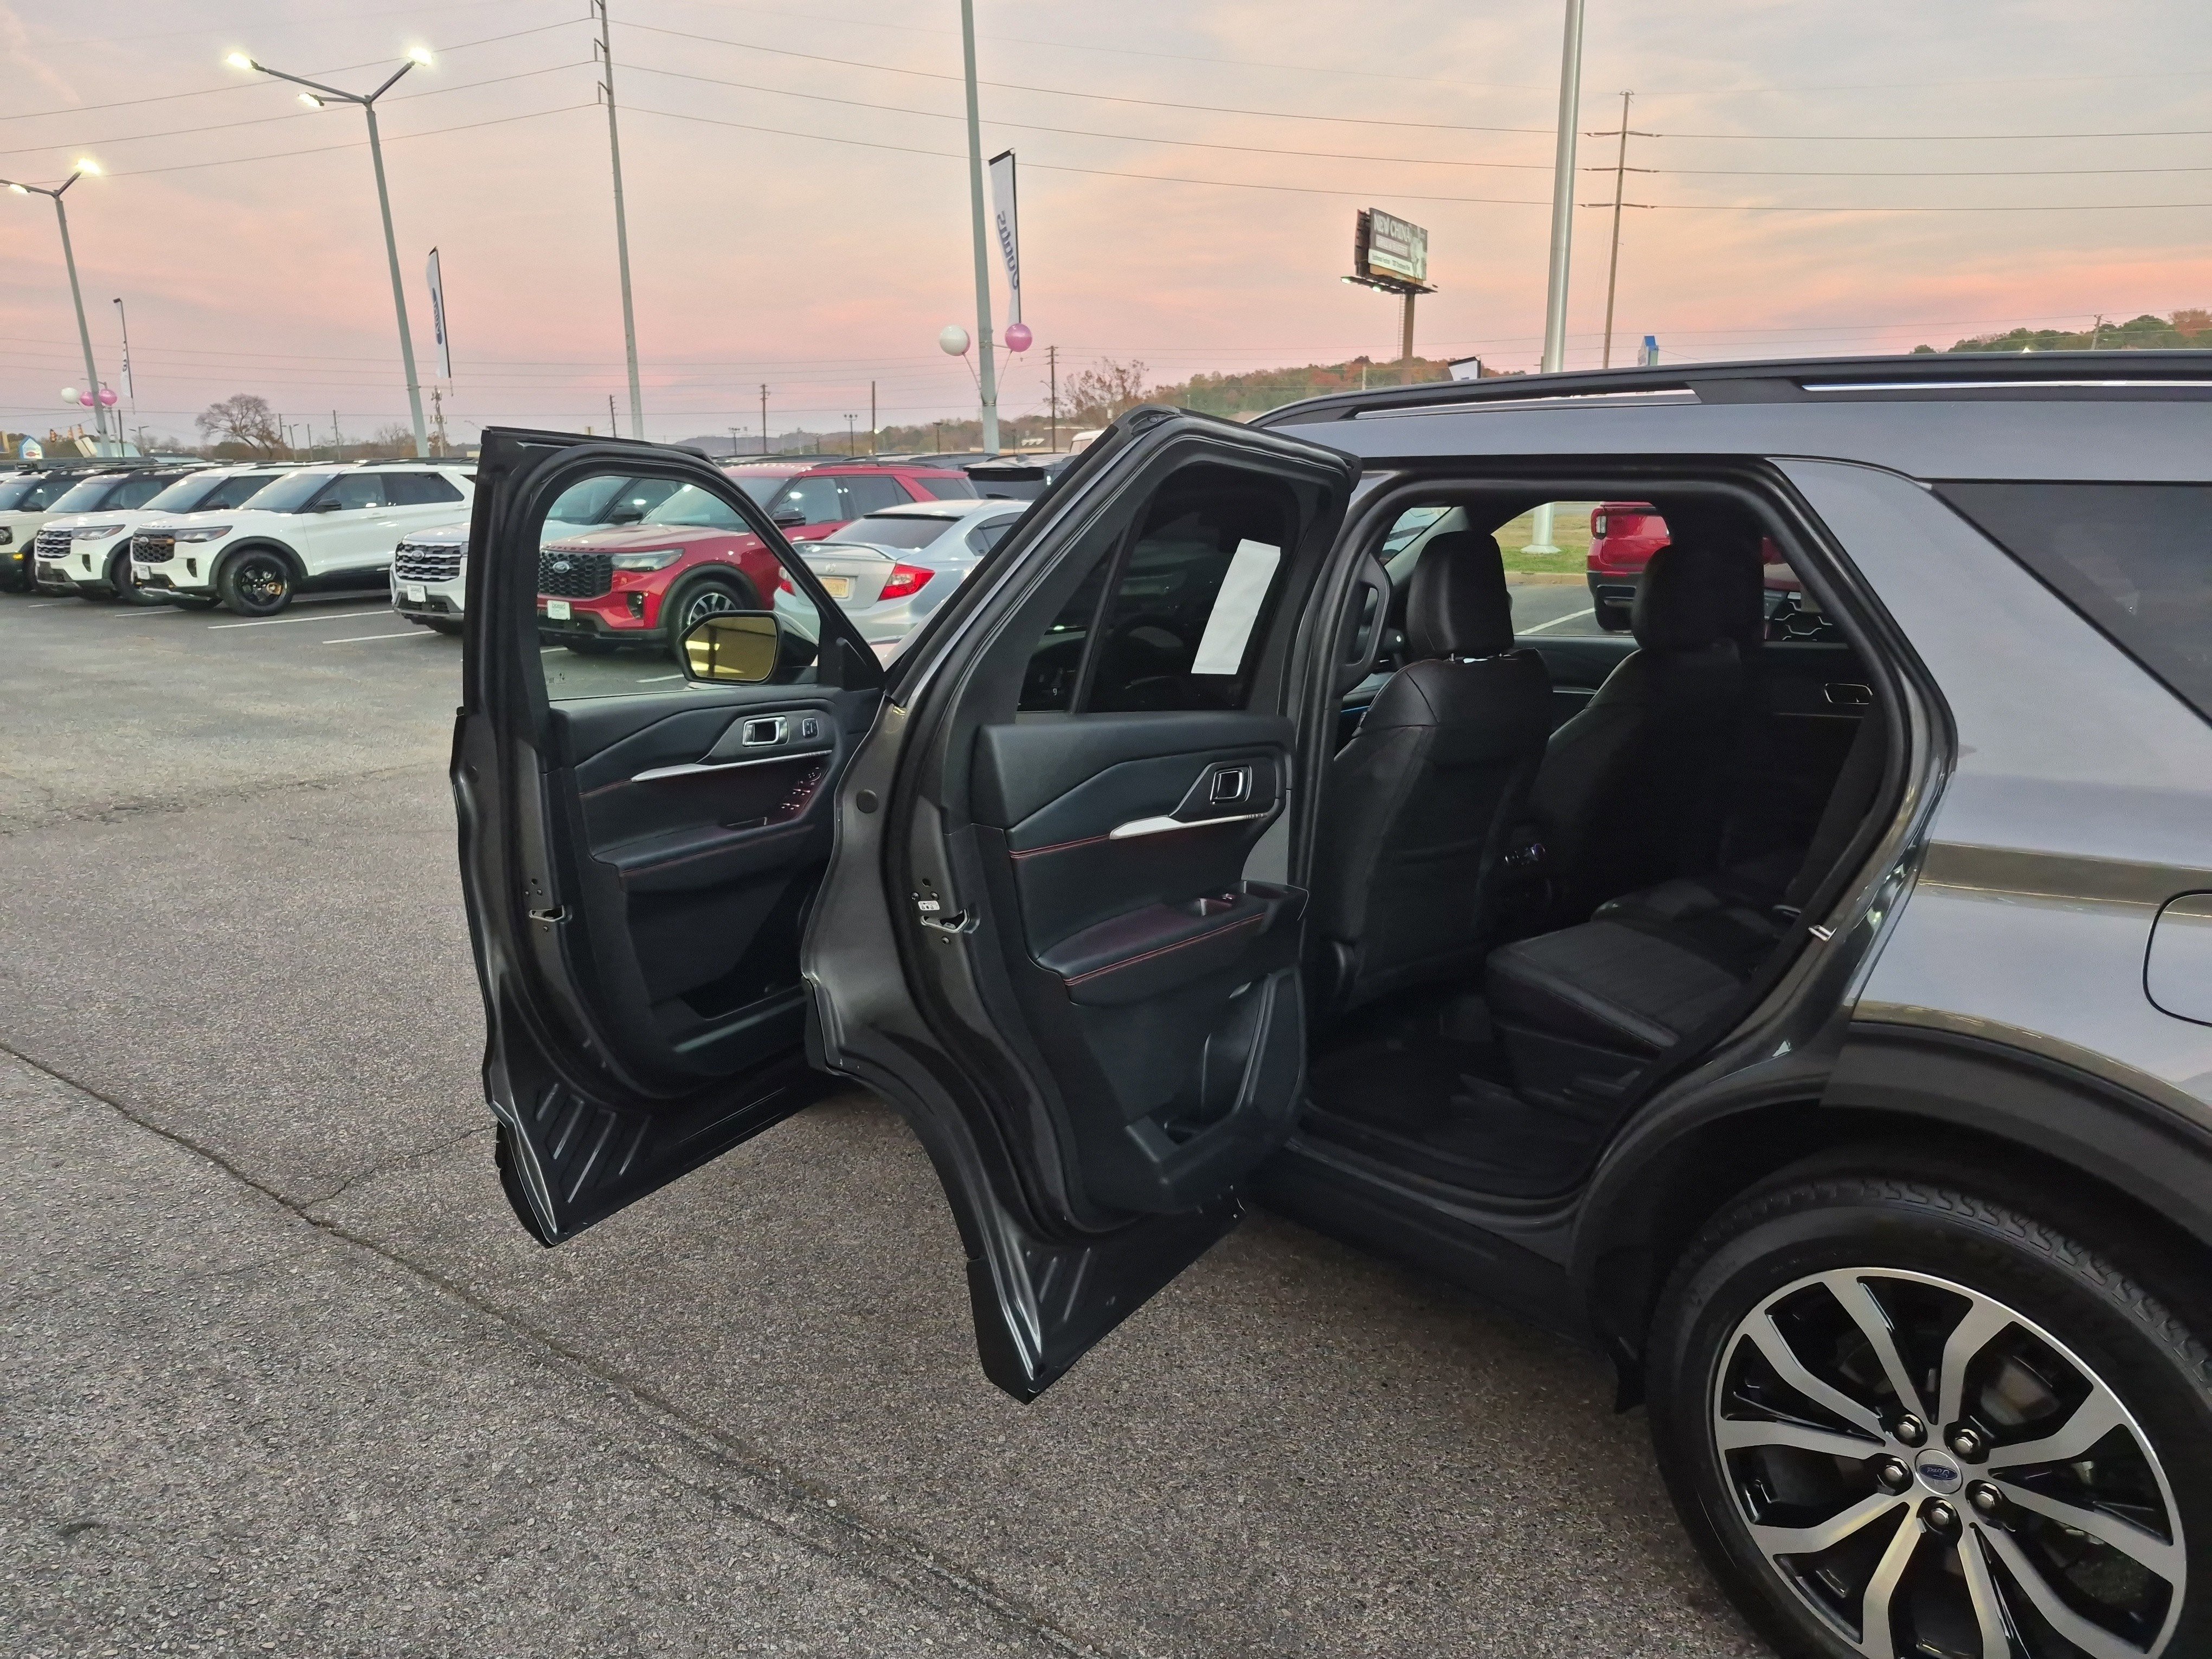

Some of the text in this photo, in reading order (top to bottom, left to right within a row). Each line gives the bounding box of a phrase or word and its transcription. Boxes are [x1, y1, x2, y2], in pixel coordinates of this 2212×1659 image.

[1373, 214, 1411, 243] NEW CHINA
[1927, 1467, 1950, 1478] Ford
